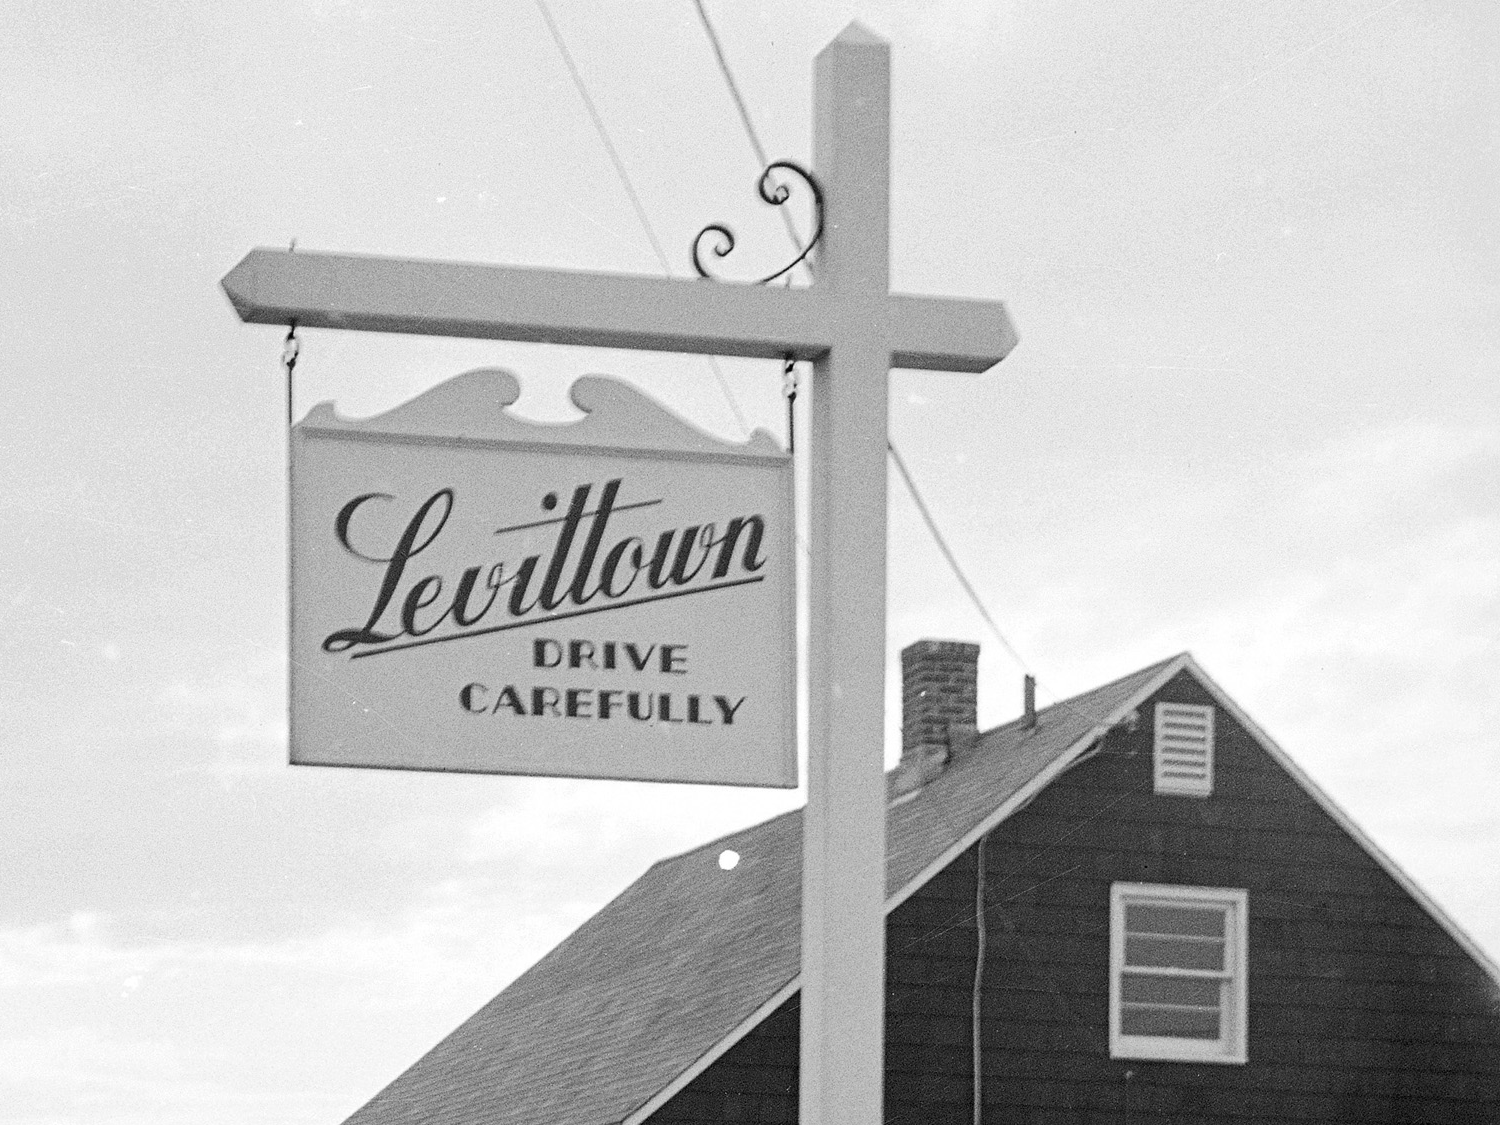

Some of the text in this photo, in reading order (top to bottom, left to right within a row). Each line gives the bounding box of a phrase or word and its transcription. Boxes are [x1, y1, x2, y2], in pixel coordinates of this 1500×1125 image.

[321, 477, 767, 653] Levittown
[532, 638, 689, 675] DRIVE
[458, 682, 747, 725] CAREFULLY
